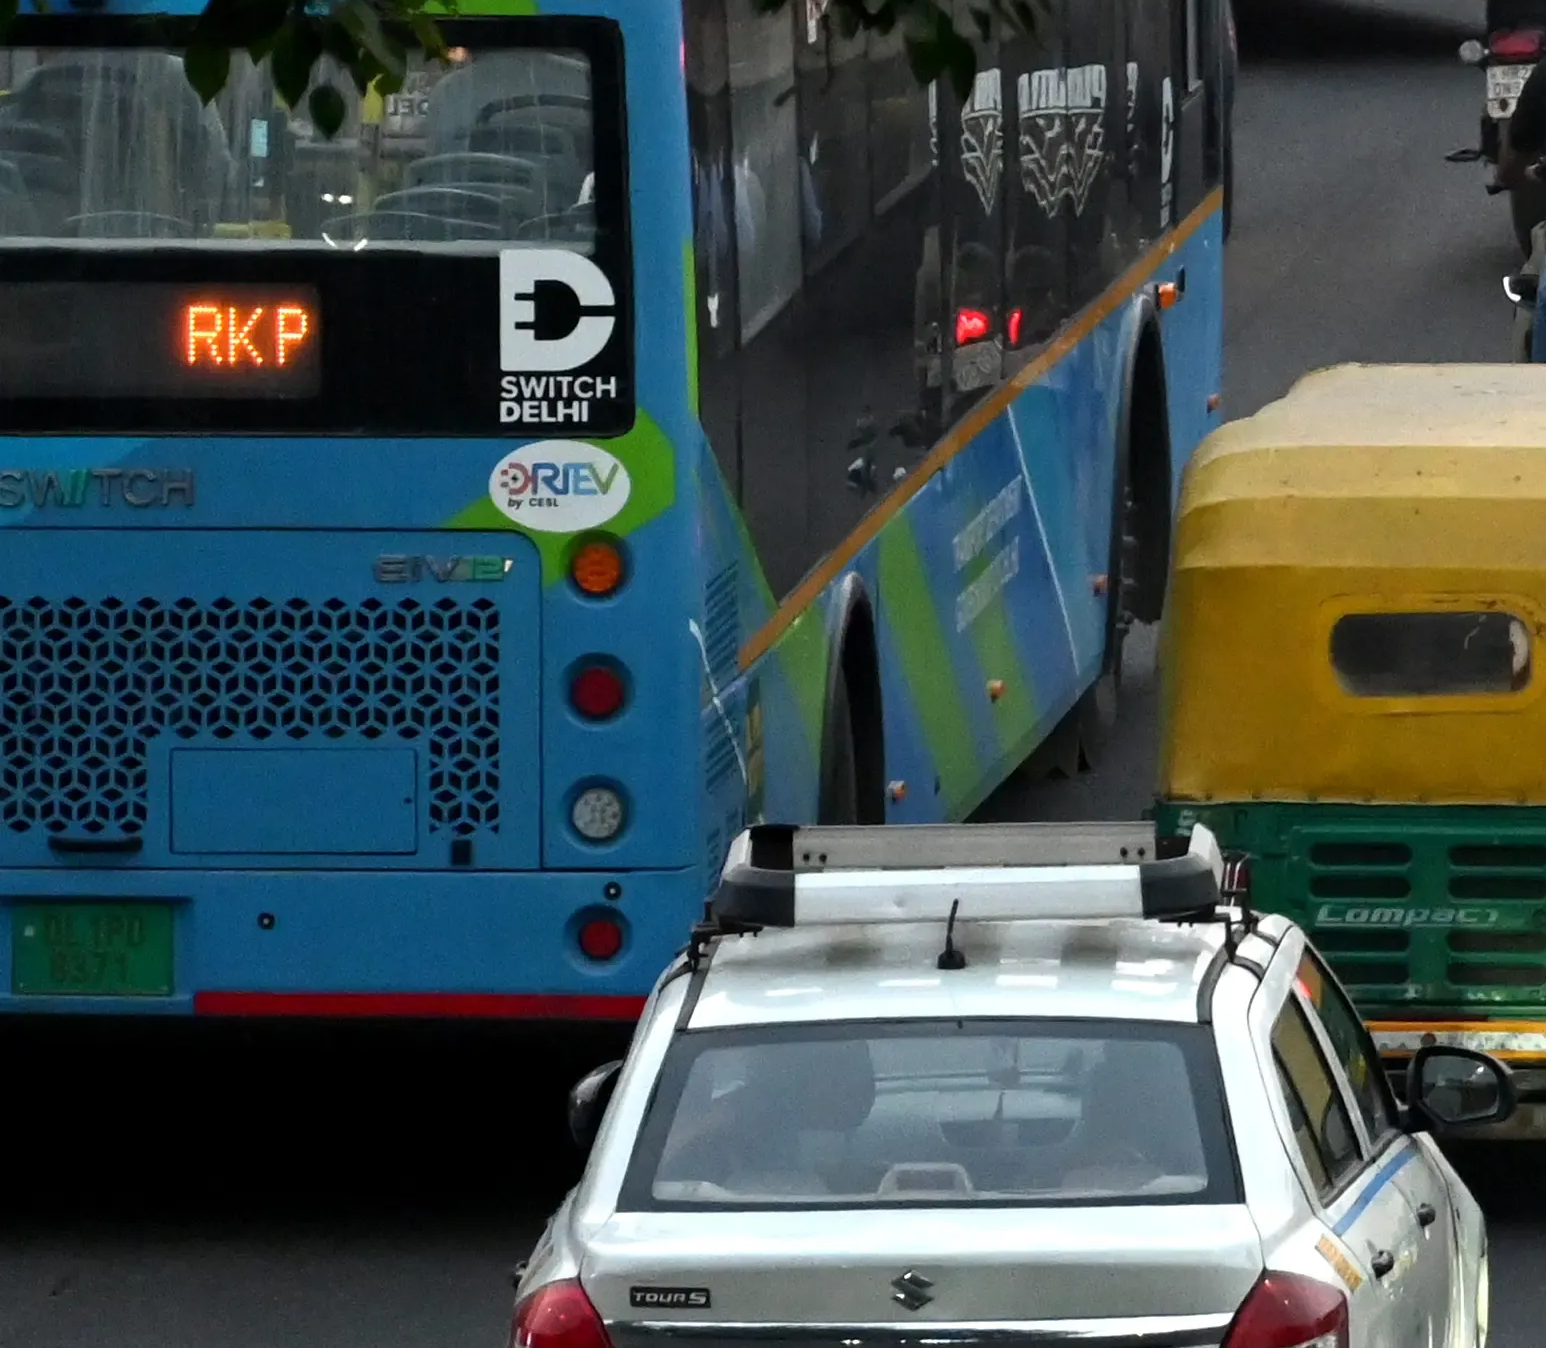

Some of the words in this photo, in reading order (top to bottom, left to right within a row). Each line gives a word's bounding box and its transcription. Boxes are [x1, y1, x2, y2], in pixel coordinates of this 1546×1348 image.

[186, 304, 309, 366] RKP
[500, 375, 617, 399] SWITCH
[500, 401, 589, 423] DELHI
[507, 498, 524, 510] by
[529, 498, 560, 508] CESL
[633, 1291, 686, 1303] TOUR
[687, 1291, 708, 1305] S
